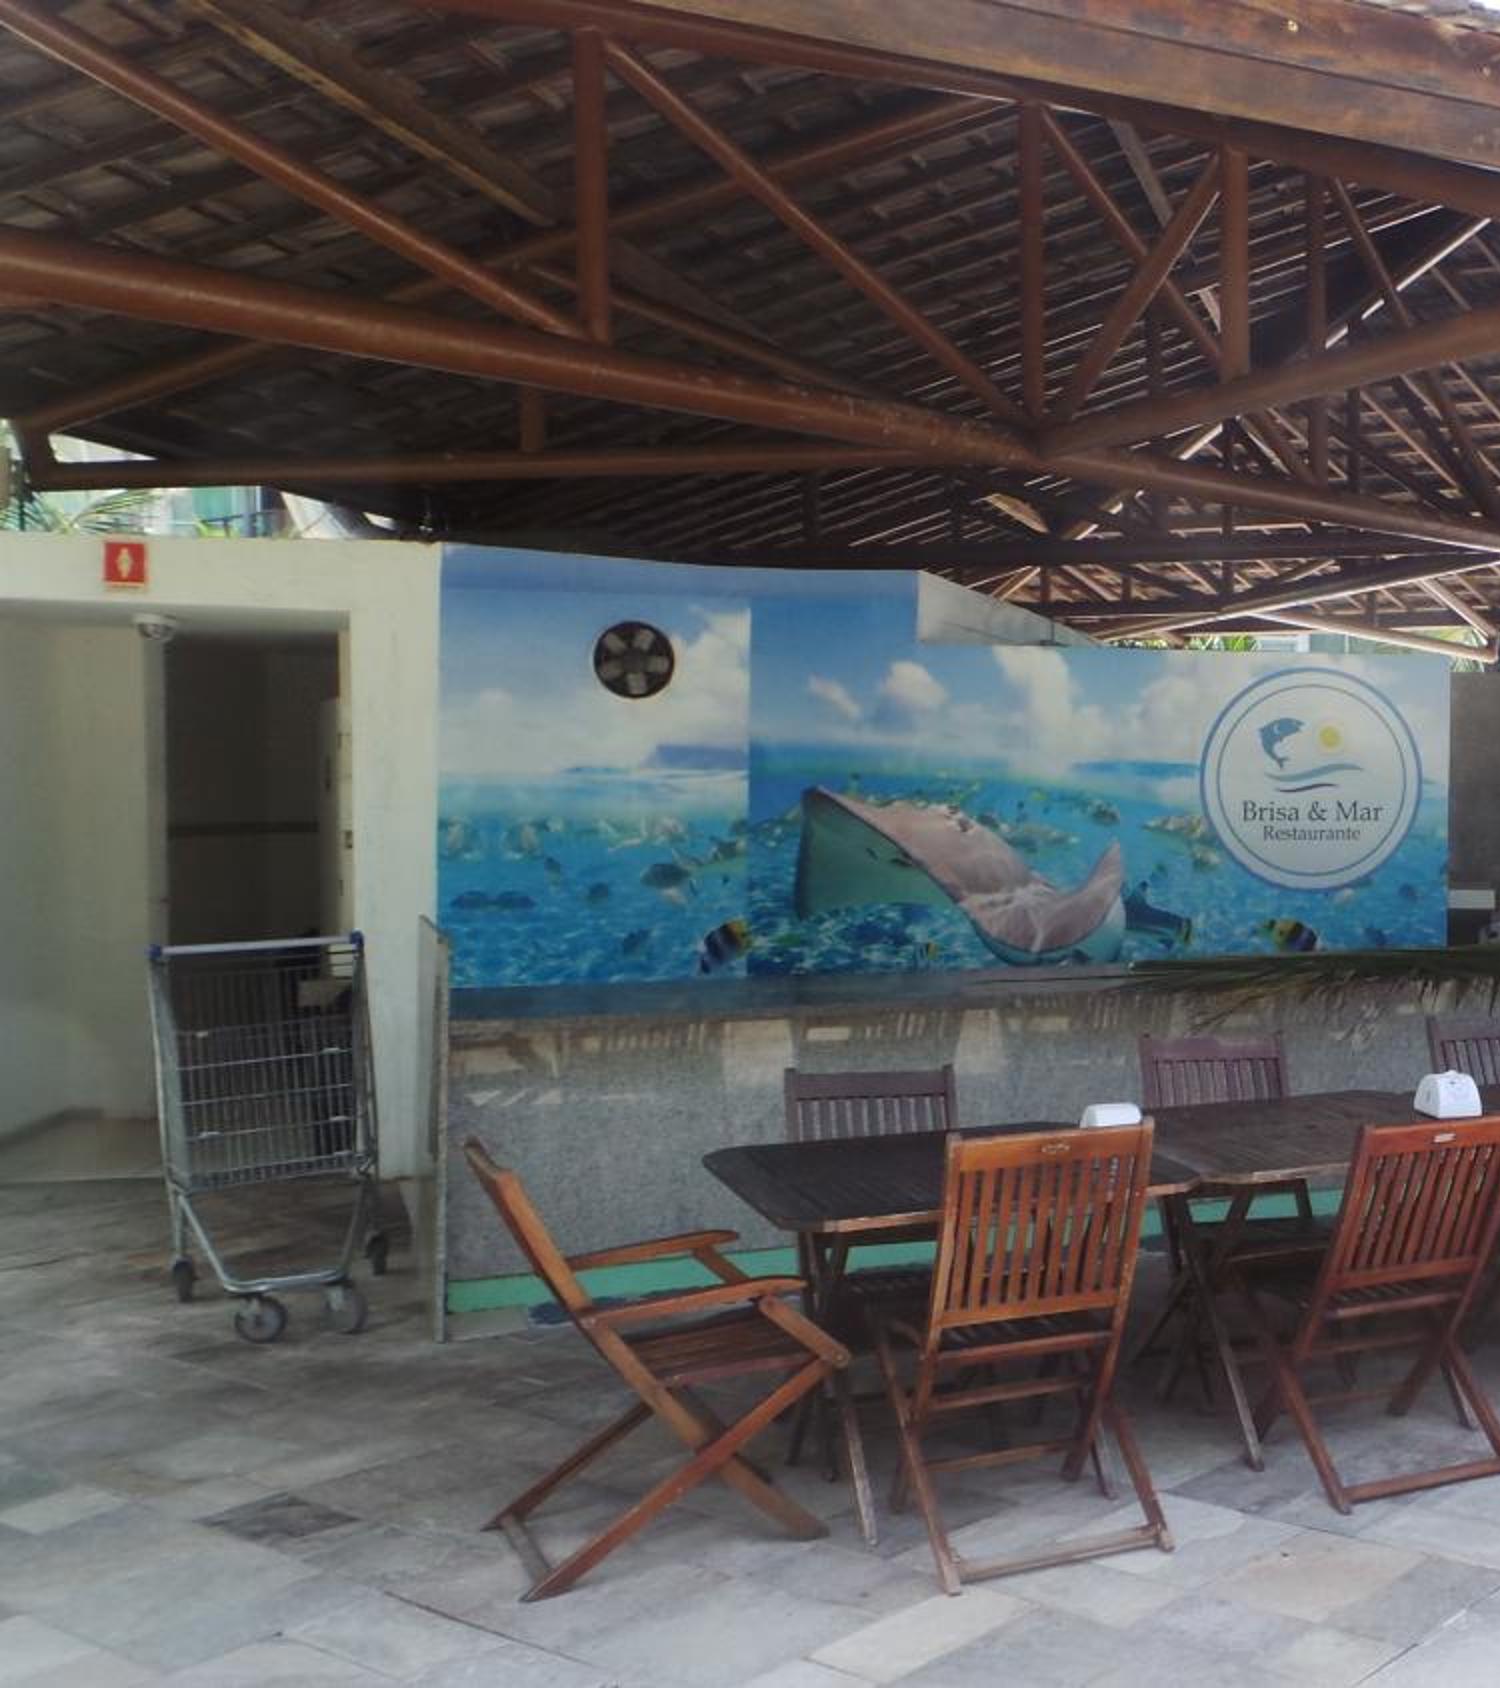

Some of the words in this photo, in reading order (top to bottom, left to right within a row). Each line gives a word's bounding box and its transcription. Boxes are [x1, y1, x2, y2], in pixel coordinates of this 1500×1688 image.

[1242, 800, 1299, 821] Brisa
[1308, 800, 1328, 821] &
[1336, 800, 1383, 821] Mar
[1263, 825, 1361, 841] Restaurante
